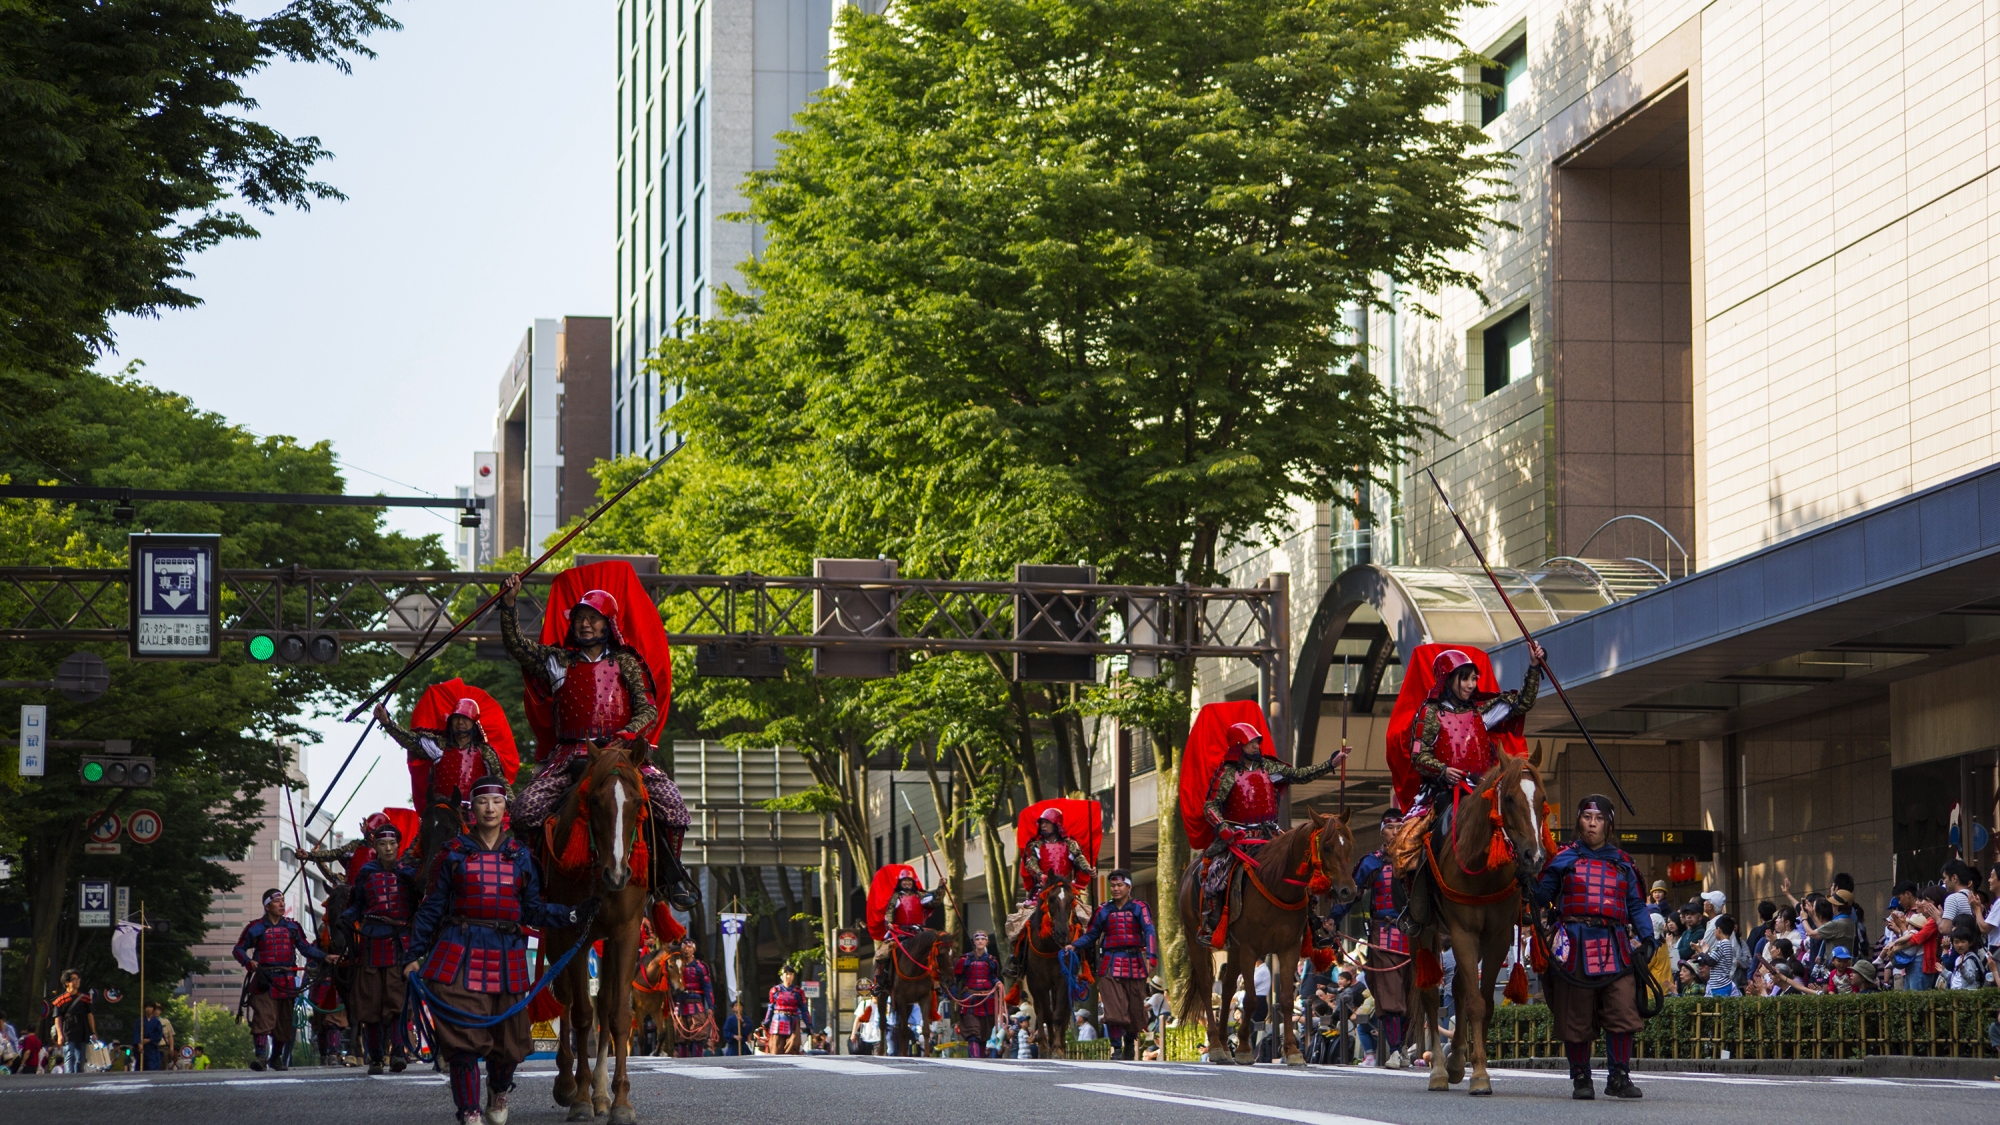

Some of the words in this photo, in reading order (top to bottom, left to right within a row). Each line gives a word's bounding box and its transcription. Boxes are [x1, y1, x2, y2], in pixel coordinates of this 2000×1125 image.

[158, 575, 192, 590] 専用
[139, 635, 209, 646] 4人以上乗車の自動車
[25, 713, 39, 768] 日銀前
[135, 819, 154, 835] 40
[1666, 833, 1674, 842] 2
